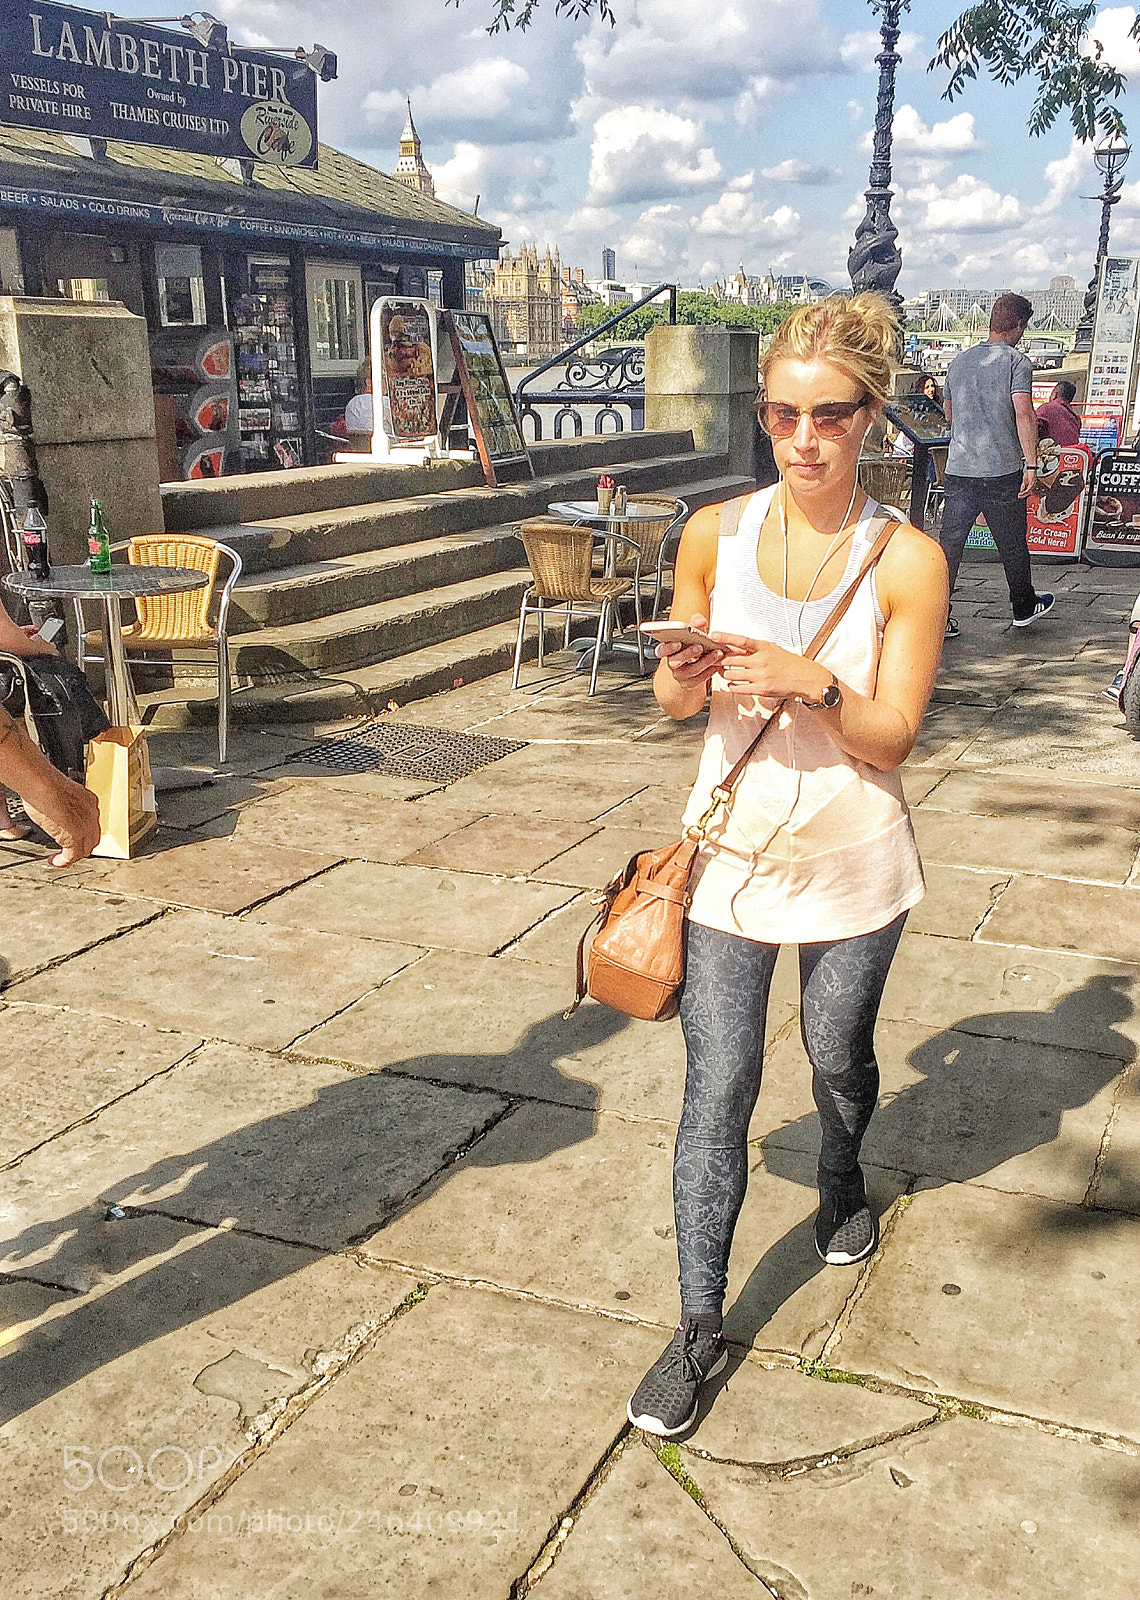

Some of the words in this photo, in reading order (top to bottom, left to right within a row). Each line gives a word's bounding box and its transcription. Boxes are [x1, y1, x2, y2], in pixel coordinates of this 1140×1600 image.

[29, 13, 210, 89] LAMBETH
[221, 56, 291, 105] PIER
[10, 73, 60, 95] VESSELS
[62, 82, 86, 99] FOR
[9, 94, 59, 115] PRIVATE
[62, 103, 92, 120] HIRE
[147, 87, 175, 102] Owned
[177, 92, 187, 107] by
[110, 101, 160, 125] THAMES
[163, 111, 207, 132] CRUISES
[209, 118, 229, 134] LTD
[0, 191, 29, 204] BEER
[40, 196, 79, 210] SALADS
[89, 202, 115, 214] COLD
[116, 205, 151, 218] DRINKS
[240, 221, 270, 233] COFFEE
[274, 225, 319, 237] SANDWICHES
[1101, 473, 1140, 486] COFF
[1028, 535, 1046, 544] Sold
[1047, 538, 1067, 548] Here!
[1030, 526, 1042, 535] Ice
[1044, 528, 1068, 538] Cream
[1096, 530, 1116, 539] Bean
